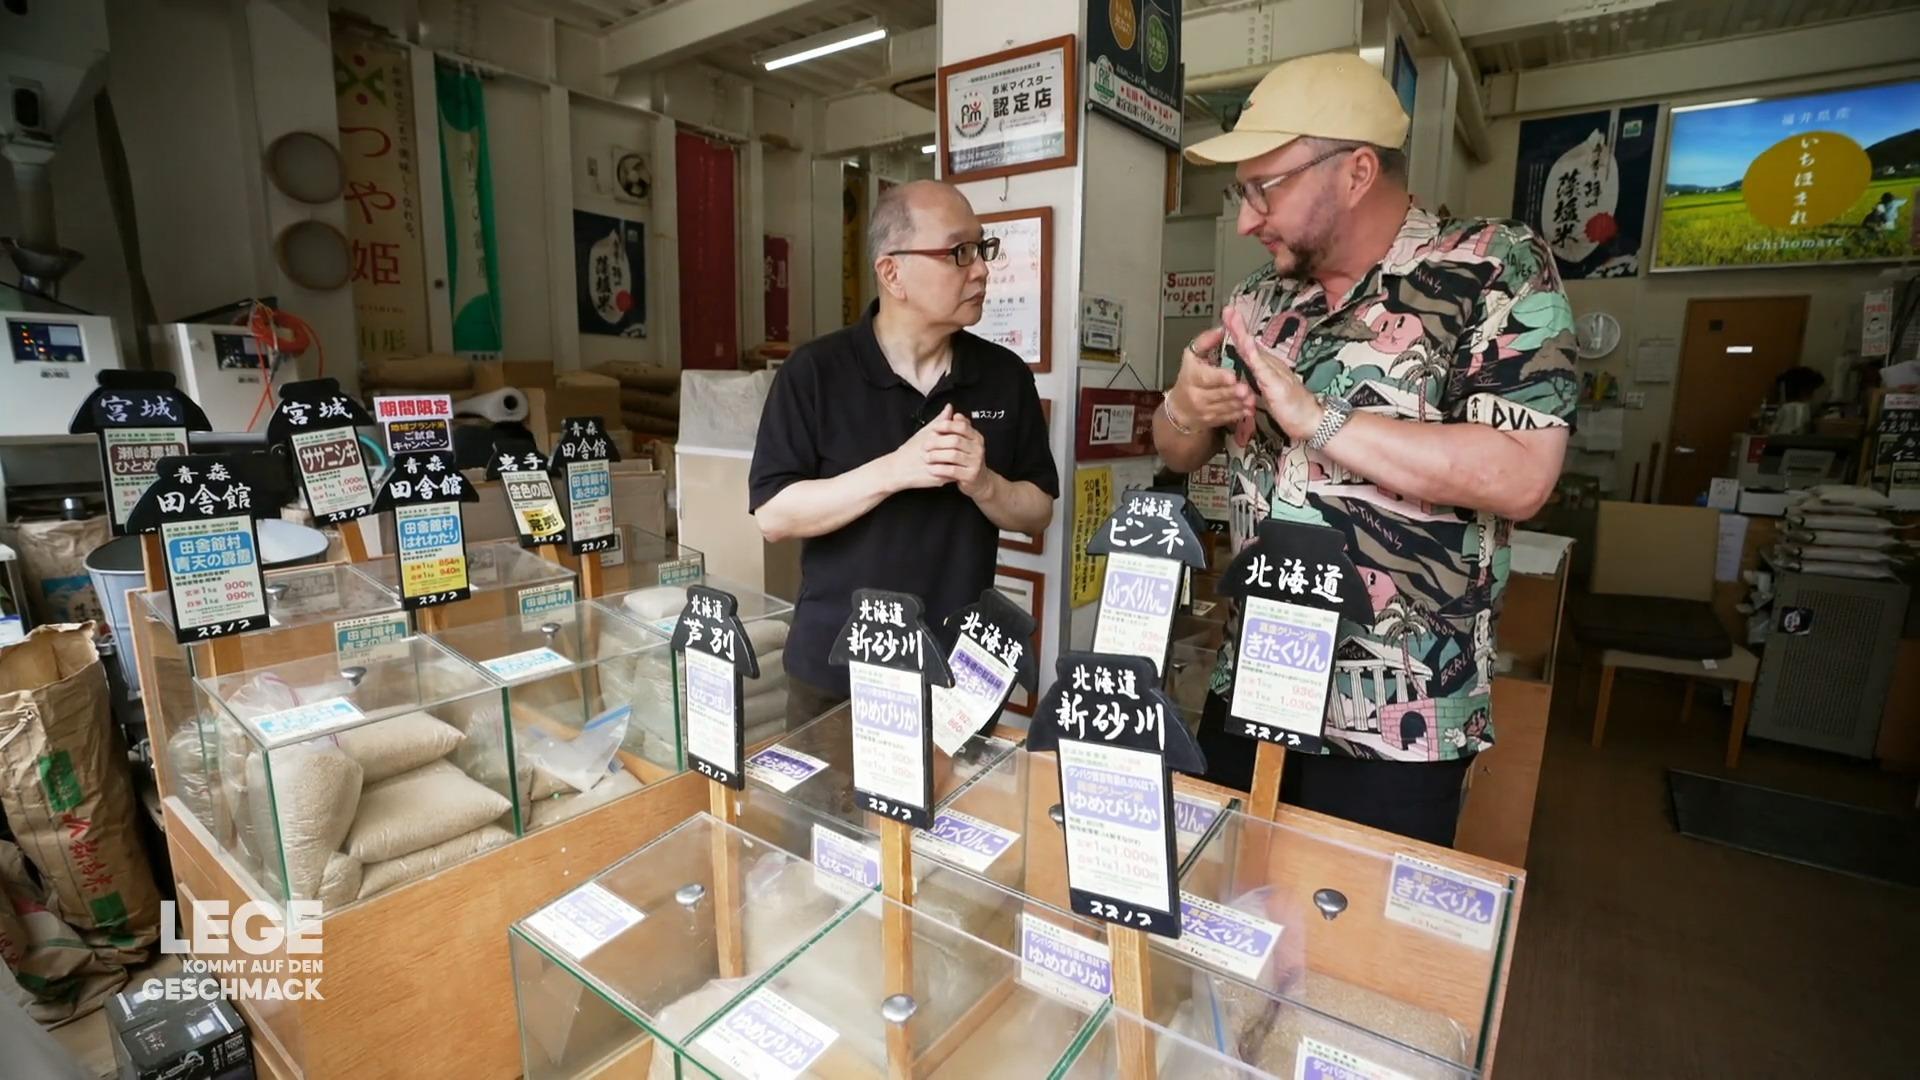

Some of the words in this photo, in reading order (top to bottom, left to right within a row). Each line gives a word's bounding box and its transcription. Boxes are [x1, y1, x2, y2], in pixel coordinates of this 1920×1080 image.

[993, 87, 1052, 118] 認定店
[1789, 136, 1819, 226] いちほまれ
[339, 126, 401, 286] つや姫
[100, 395, 179, 423] 宮城
[282, 396, 354, 425] 宮城
[379, 398, 450, 417] 期間限定
[404, 430, 436, 441] ご試食
[571, 421, 598, 437] 青森
[302, 441, 357, 472] ササニシキ
[392, 438, 448, 450] キャンペーン
[561, 437, 607, 460] 田舎館
[115, 461, 157, 473] ひとめ
[173, 462, 232, 485] 青森
[403, 456, 446, 474] 青森
[497, 452, 543, 471] 岩手
[156, 482, 253, 516] 田舎館
[389, 473, 464, 501] 田舎館
[510, 482, 552, 499] 金色の風
[1127, 497, 1173, 521] 北海道
[402, 531, 460, 549] はれわたり
[404, 519, 455, 535] 田舎館村
[1109, 517, 1184, 555] ピンネ
[179, 535, 241, 555] 田舎館村
[224, 580, 253, 591] 900円
[1245, 554, 1344, 603] 北海道
[226, 591, 255, 602] 990円
[1107, 574, 1169, 614] ふっくりんこ
[691, 594, 724, 624] 北海道
[859, 599, 907, 628] 北海道
[683, 617, 735, 662] 芦別
[847, 622, 924, 670] 新砂川
[960, 611, 1023, 673] 北海道
[1245, 631, 1325, 671] きたくりん
[1072, 664, 1140, 700] 北海道
[856, 696, 918, 732] ゆめぴりか
[1056, 691, 1165, 751] 新砂川
[1070, 793, 1157, 825] ゆめぴりか
[931, 818, 1004, 854] ふっくりんこ
[1395, 876, 1488, 922] きたくりん
[1029, 944, 1106, 990] ゆめぴりか
